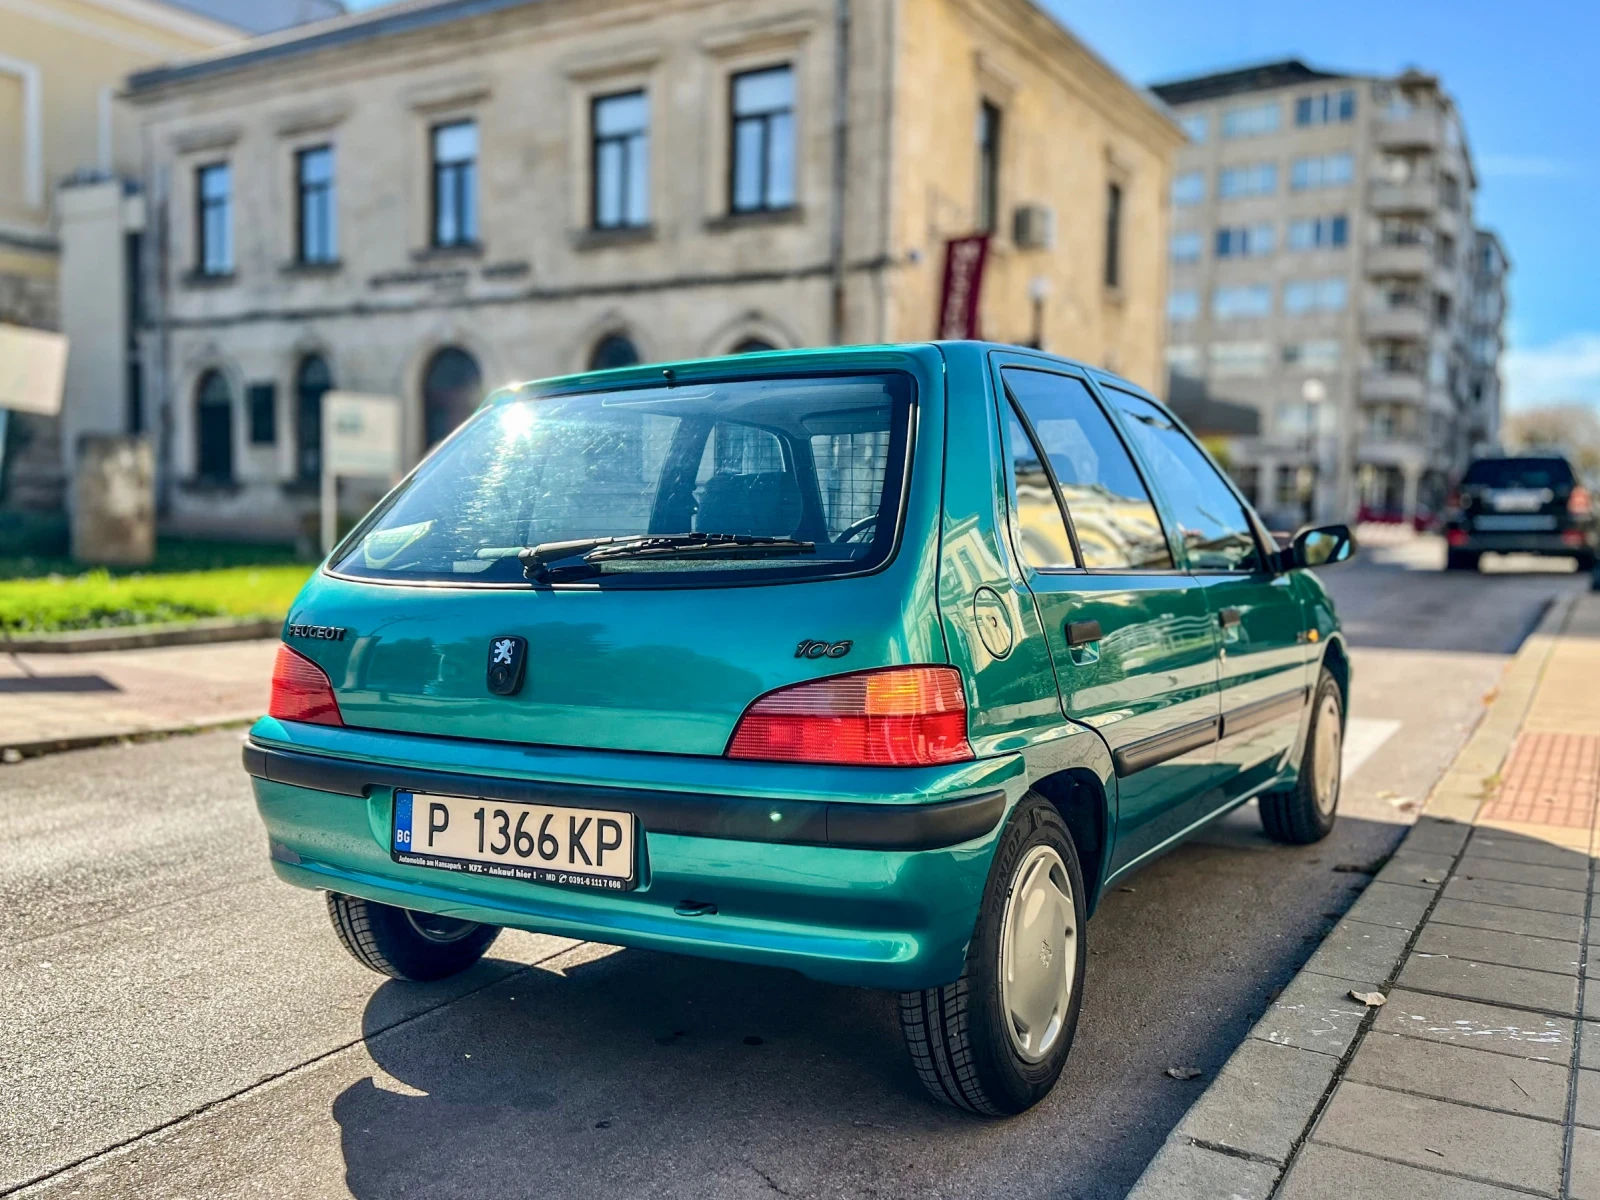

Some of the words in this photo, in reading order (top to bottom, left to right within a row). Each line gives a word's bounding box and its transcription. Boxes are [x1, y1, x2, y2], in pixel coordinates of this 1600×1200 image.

[288, 623, 346, 641] PEUGEOT
[794, 639, 853, 659] 106
[397, 829, 410, 843] BG
[428, 802, 449, 847] P
[474, 807, 559, 861] 1366
[398, 855, 426, 866] Automobile
[434, 859, 462, 870] Hansapark
[468, 864, 483, 873] KFZ
[488, 866, 515, 877] Ankauf
[515, 868, 532, 880] hier
[545, 873, 556, 882] MD
[591, 878, 602, 887] 111
[991, 828, 1021, 913] DUNLOP
